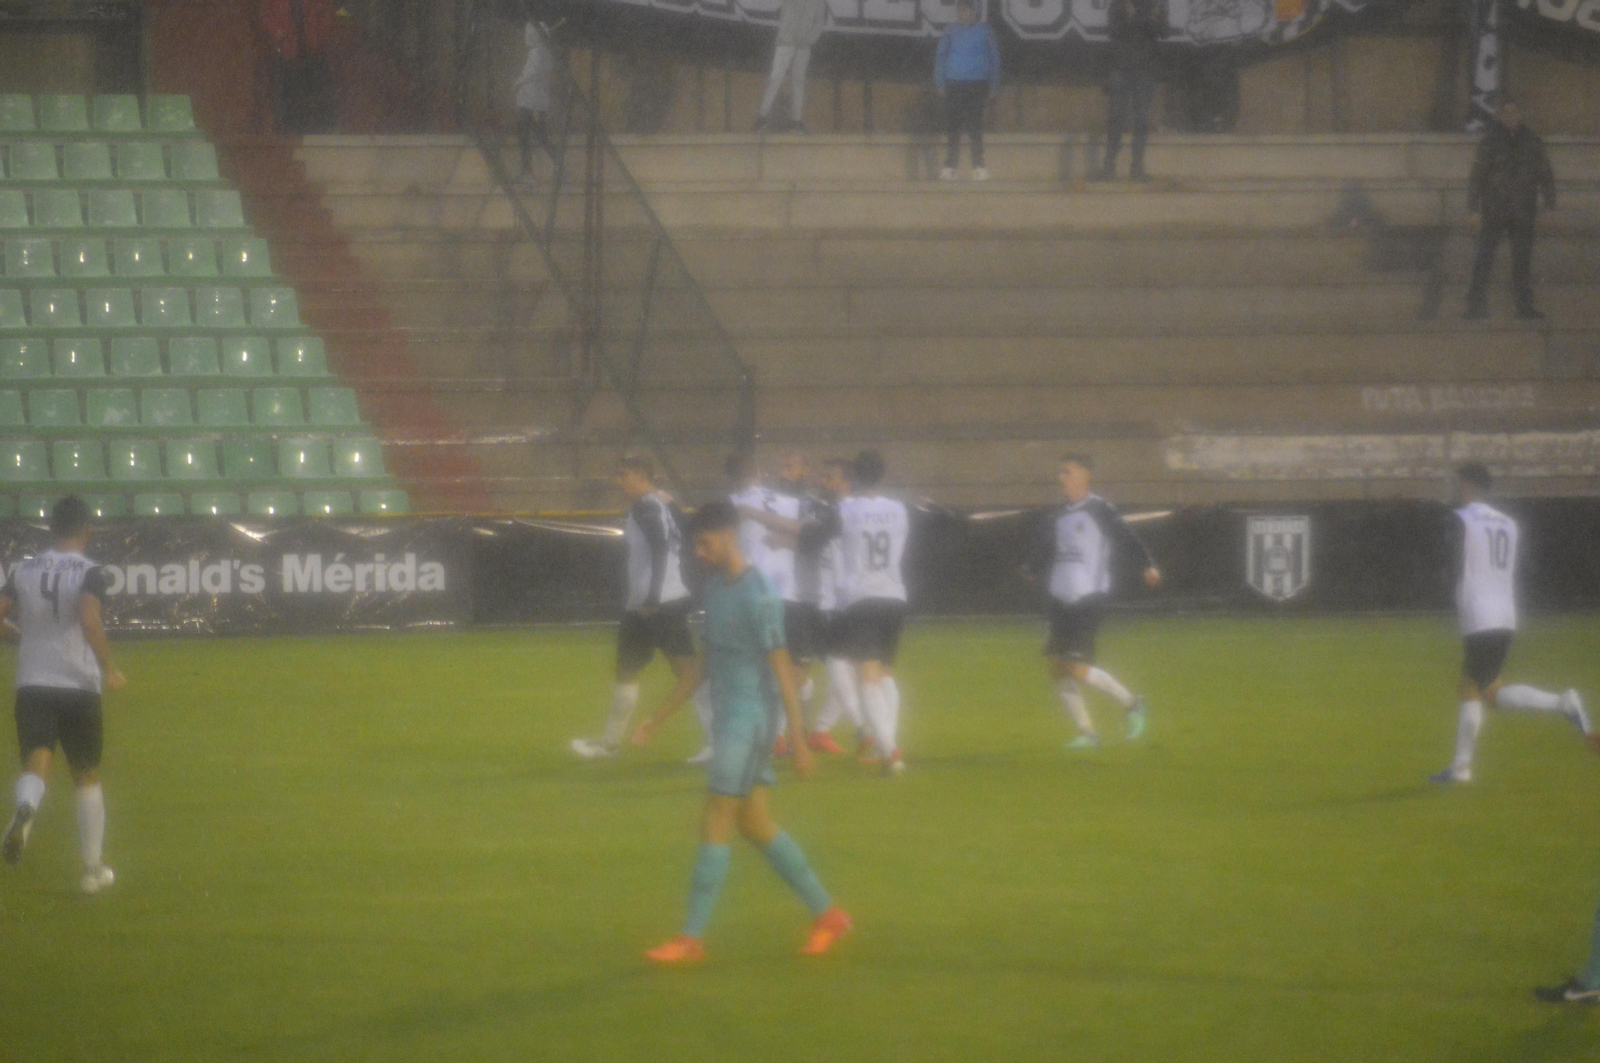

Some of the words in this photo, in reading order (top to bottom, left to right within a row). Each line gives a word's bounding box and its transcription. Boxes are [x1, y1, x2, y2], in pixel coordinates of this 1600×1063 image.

[862, 530, 891, 571] 19
[1485, 525, 1509, 571] 10
[0, 558, 265, 595] onald's
[282, 553, 446, 593] Mérida
[41, 571, 60, 617] 4
